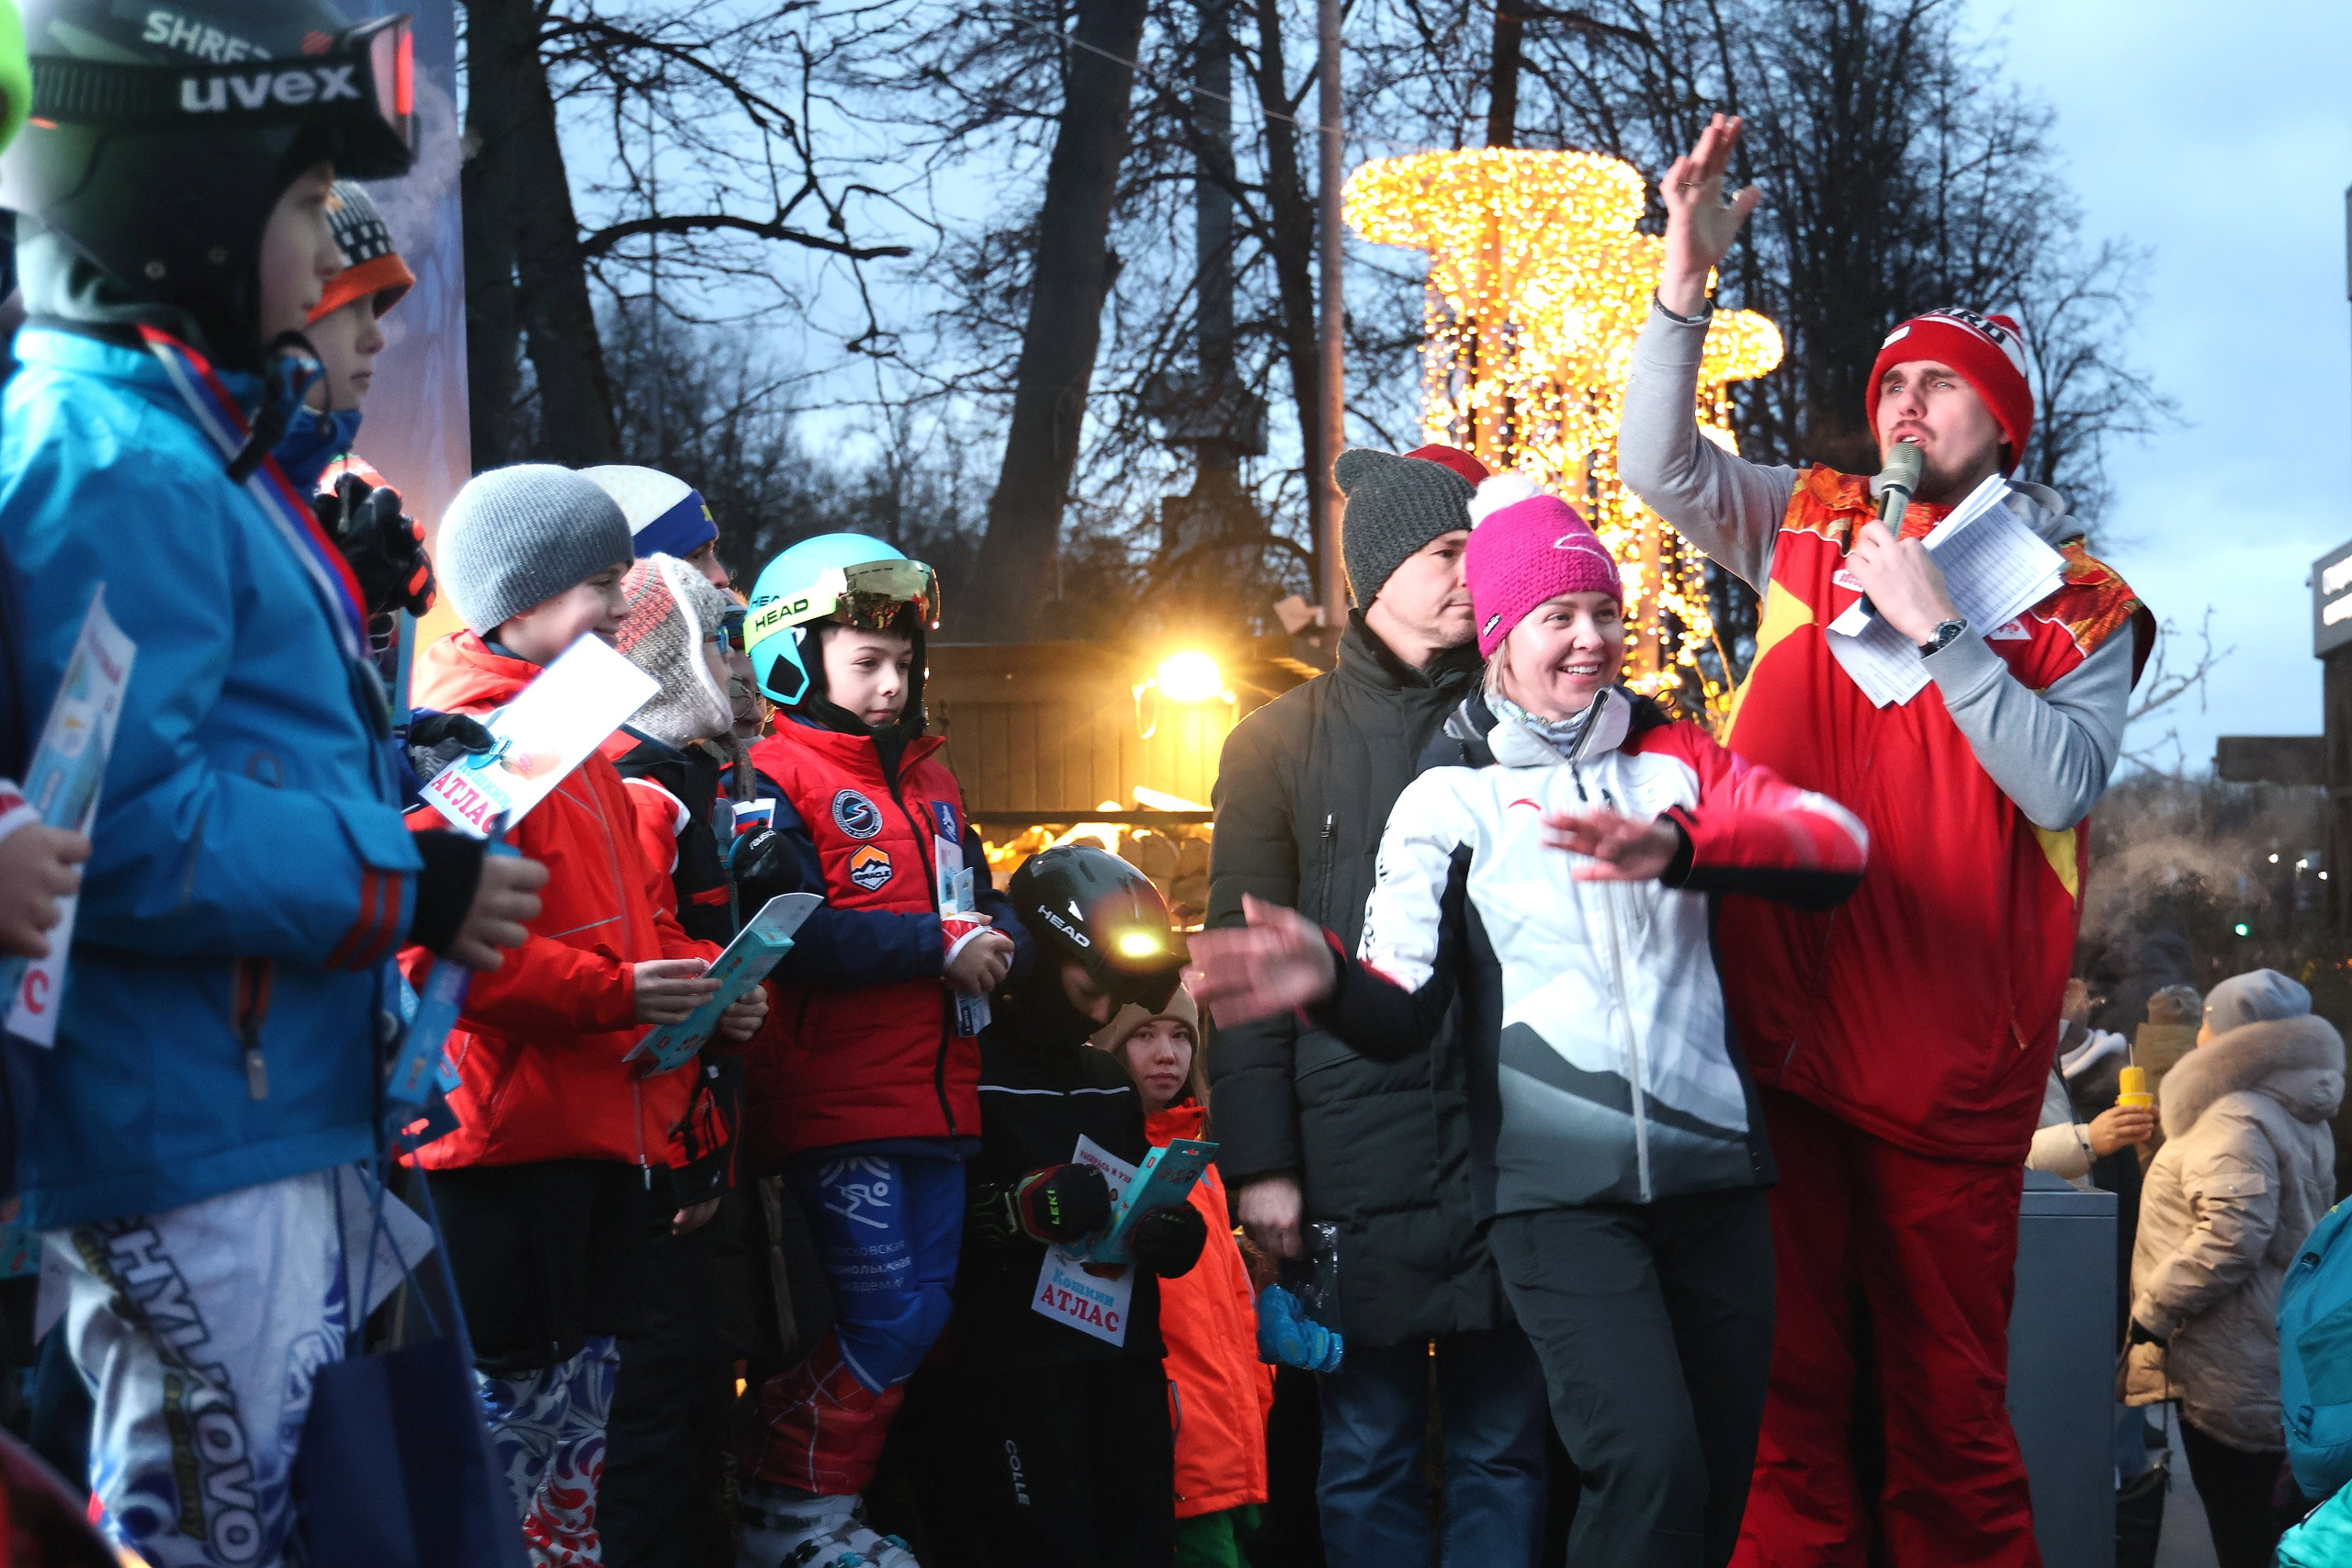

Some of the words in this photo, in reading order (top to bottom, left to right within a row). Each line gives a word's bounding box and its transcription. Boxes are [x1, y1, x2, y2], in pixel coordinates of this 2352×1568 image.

[141, 10, 273, 64] SHRE
[179, 63, 362, 113] uvex
[752, 594, 780, 608] HEA
[755, 598, 808, 632] HEAD
[1037, 905, 1091, 947] HEAD
[1046, 1189, 1061, 1225] LEKI
[1040, 1283, 1119, 1332] АТЛАС
